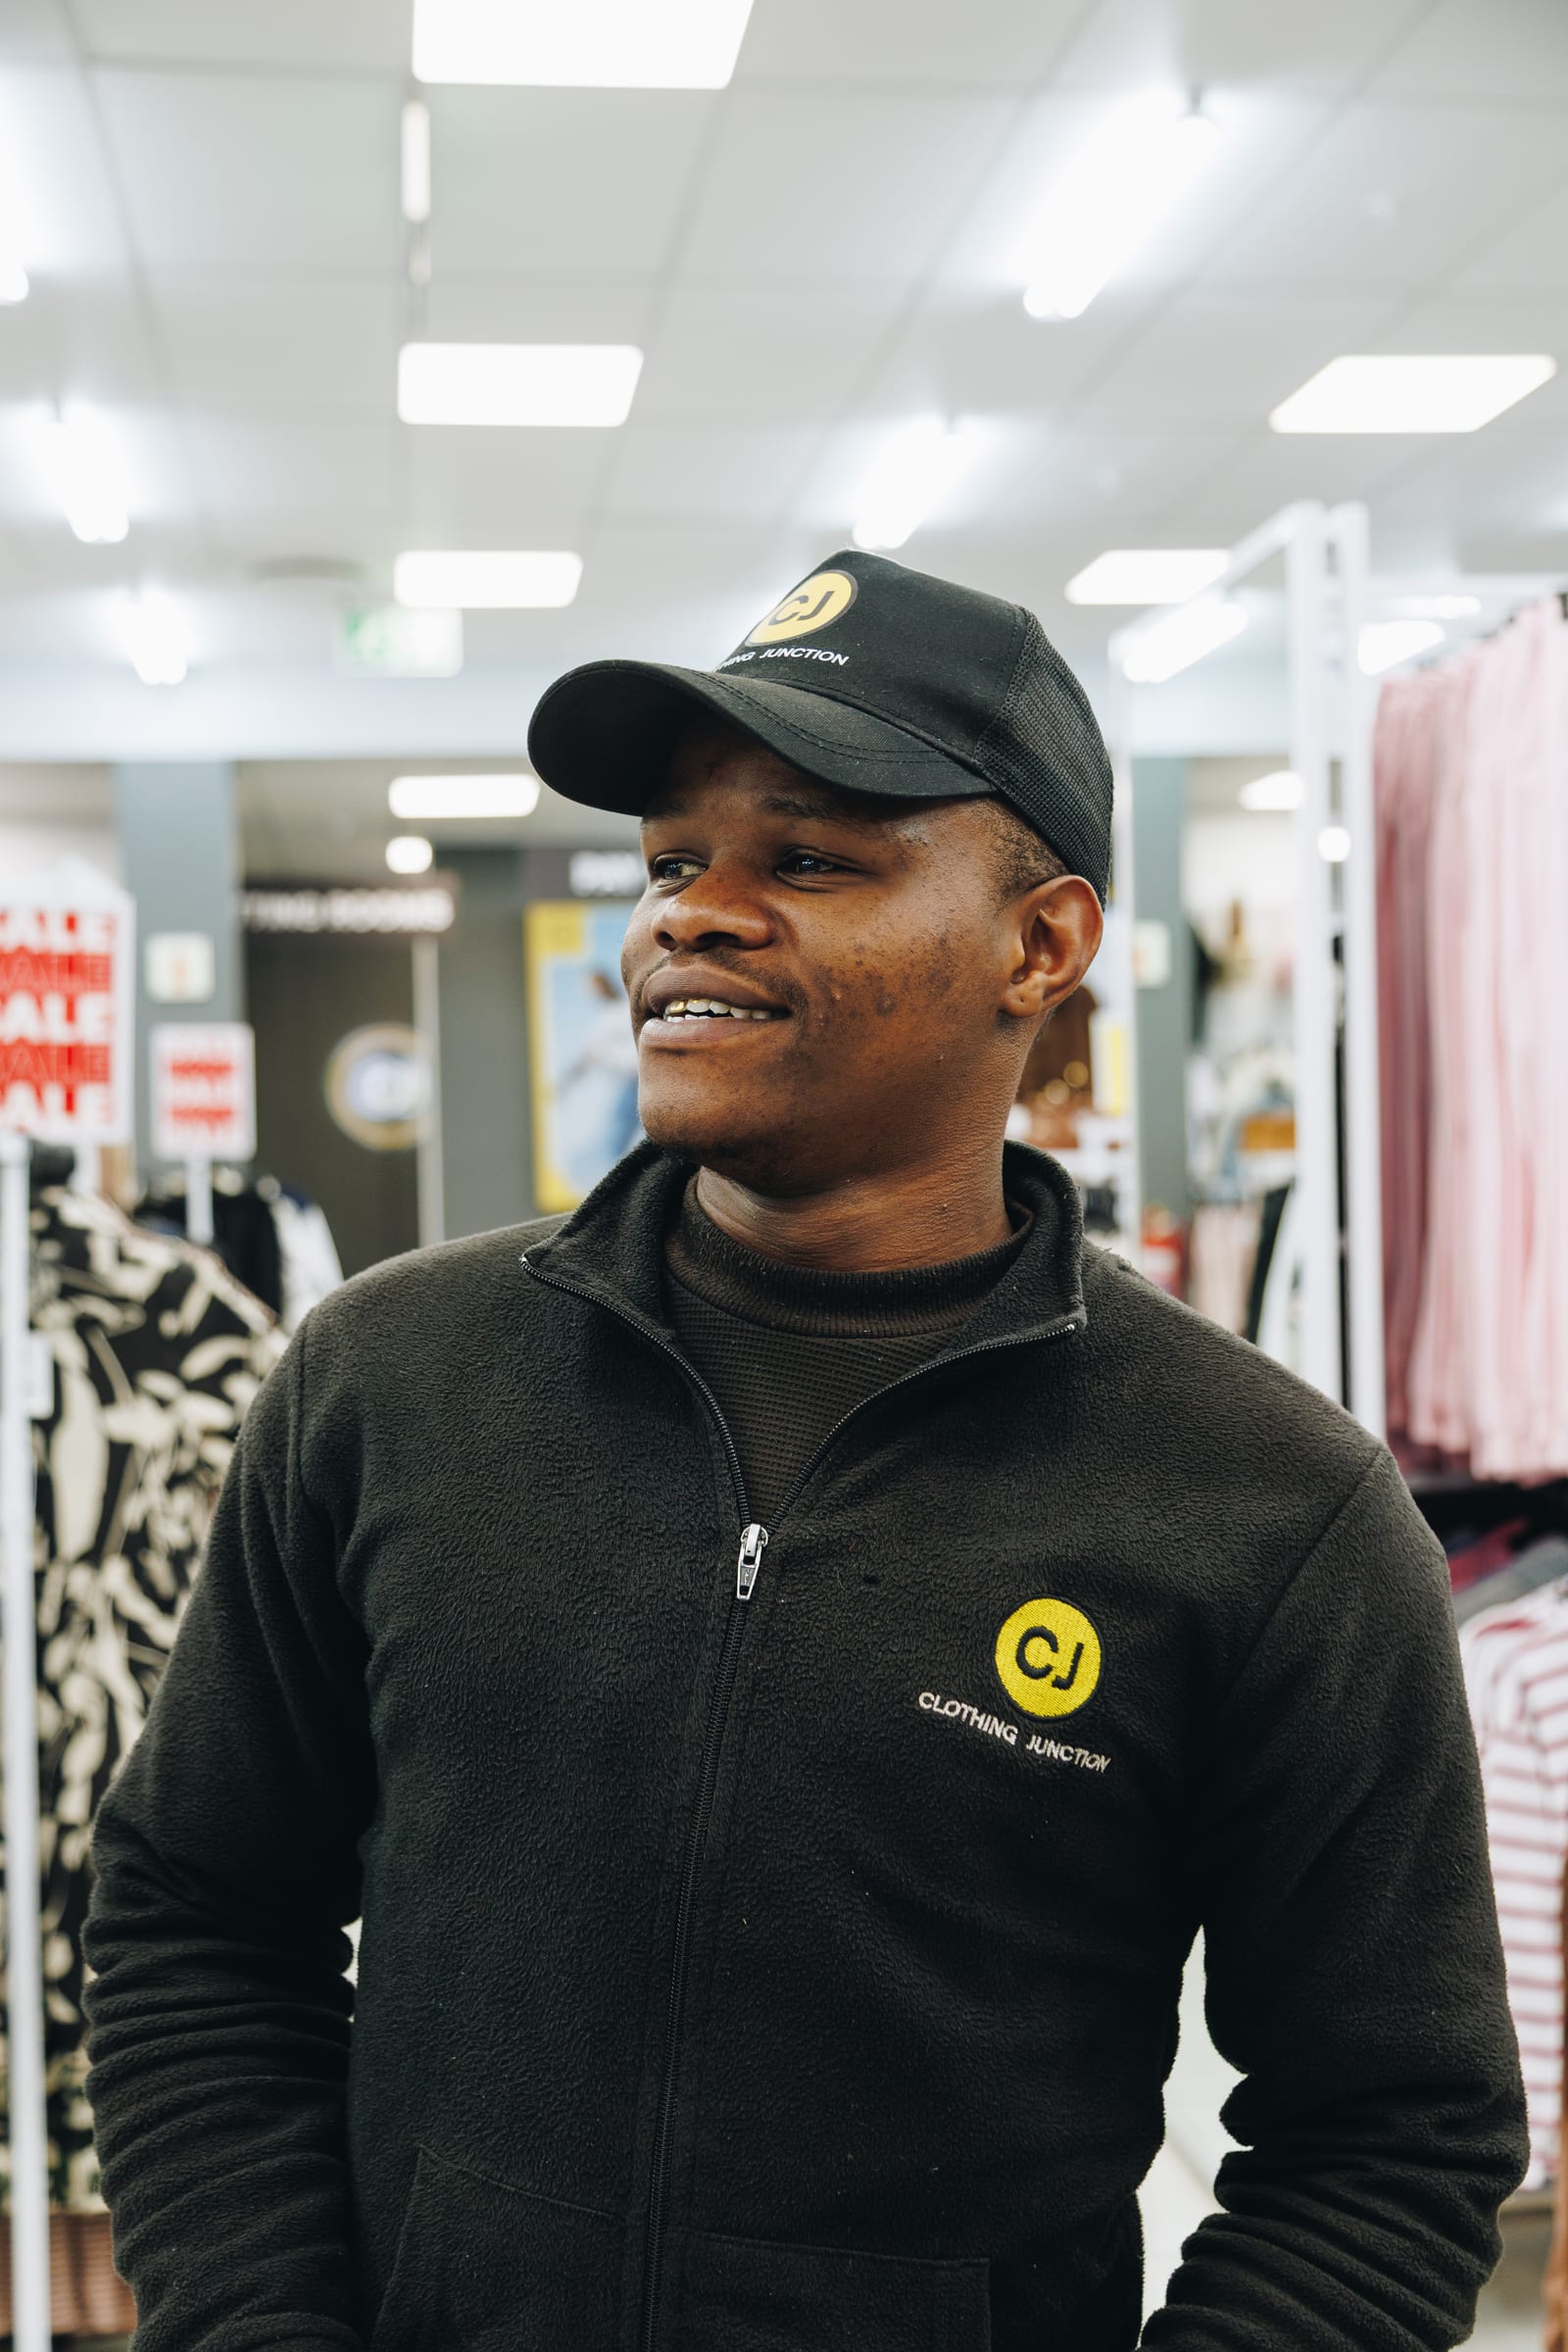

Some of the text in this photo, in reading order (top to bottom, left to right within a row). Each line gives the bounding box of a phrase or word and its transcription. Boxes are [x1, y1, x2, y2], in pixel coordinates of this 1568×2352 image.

[767, 590, 836, 626] CJ
[759, 647, 850, 665] JUNCTION
[0, 906, 115, 953] ALE
[0, 992, 115, 1045] ALE
[0, 1083, 114, 1133] ALE
[1015, 1625, 1085, 1690] CJ
[917, 1691, 1111, 1774] CLOTHING JUNCTION
